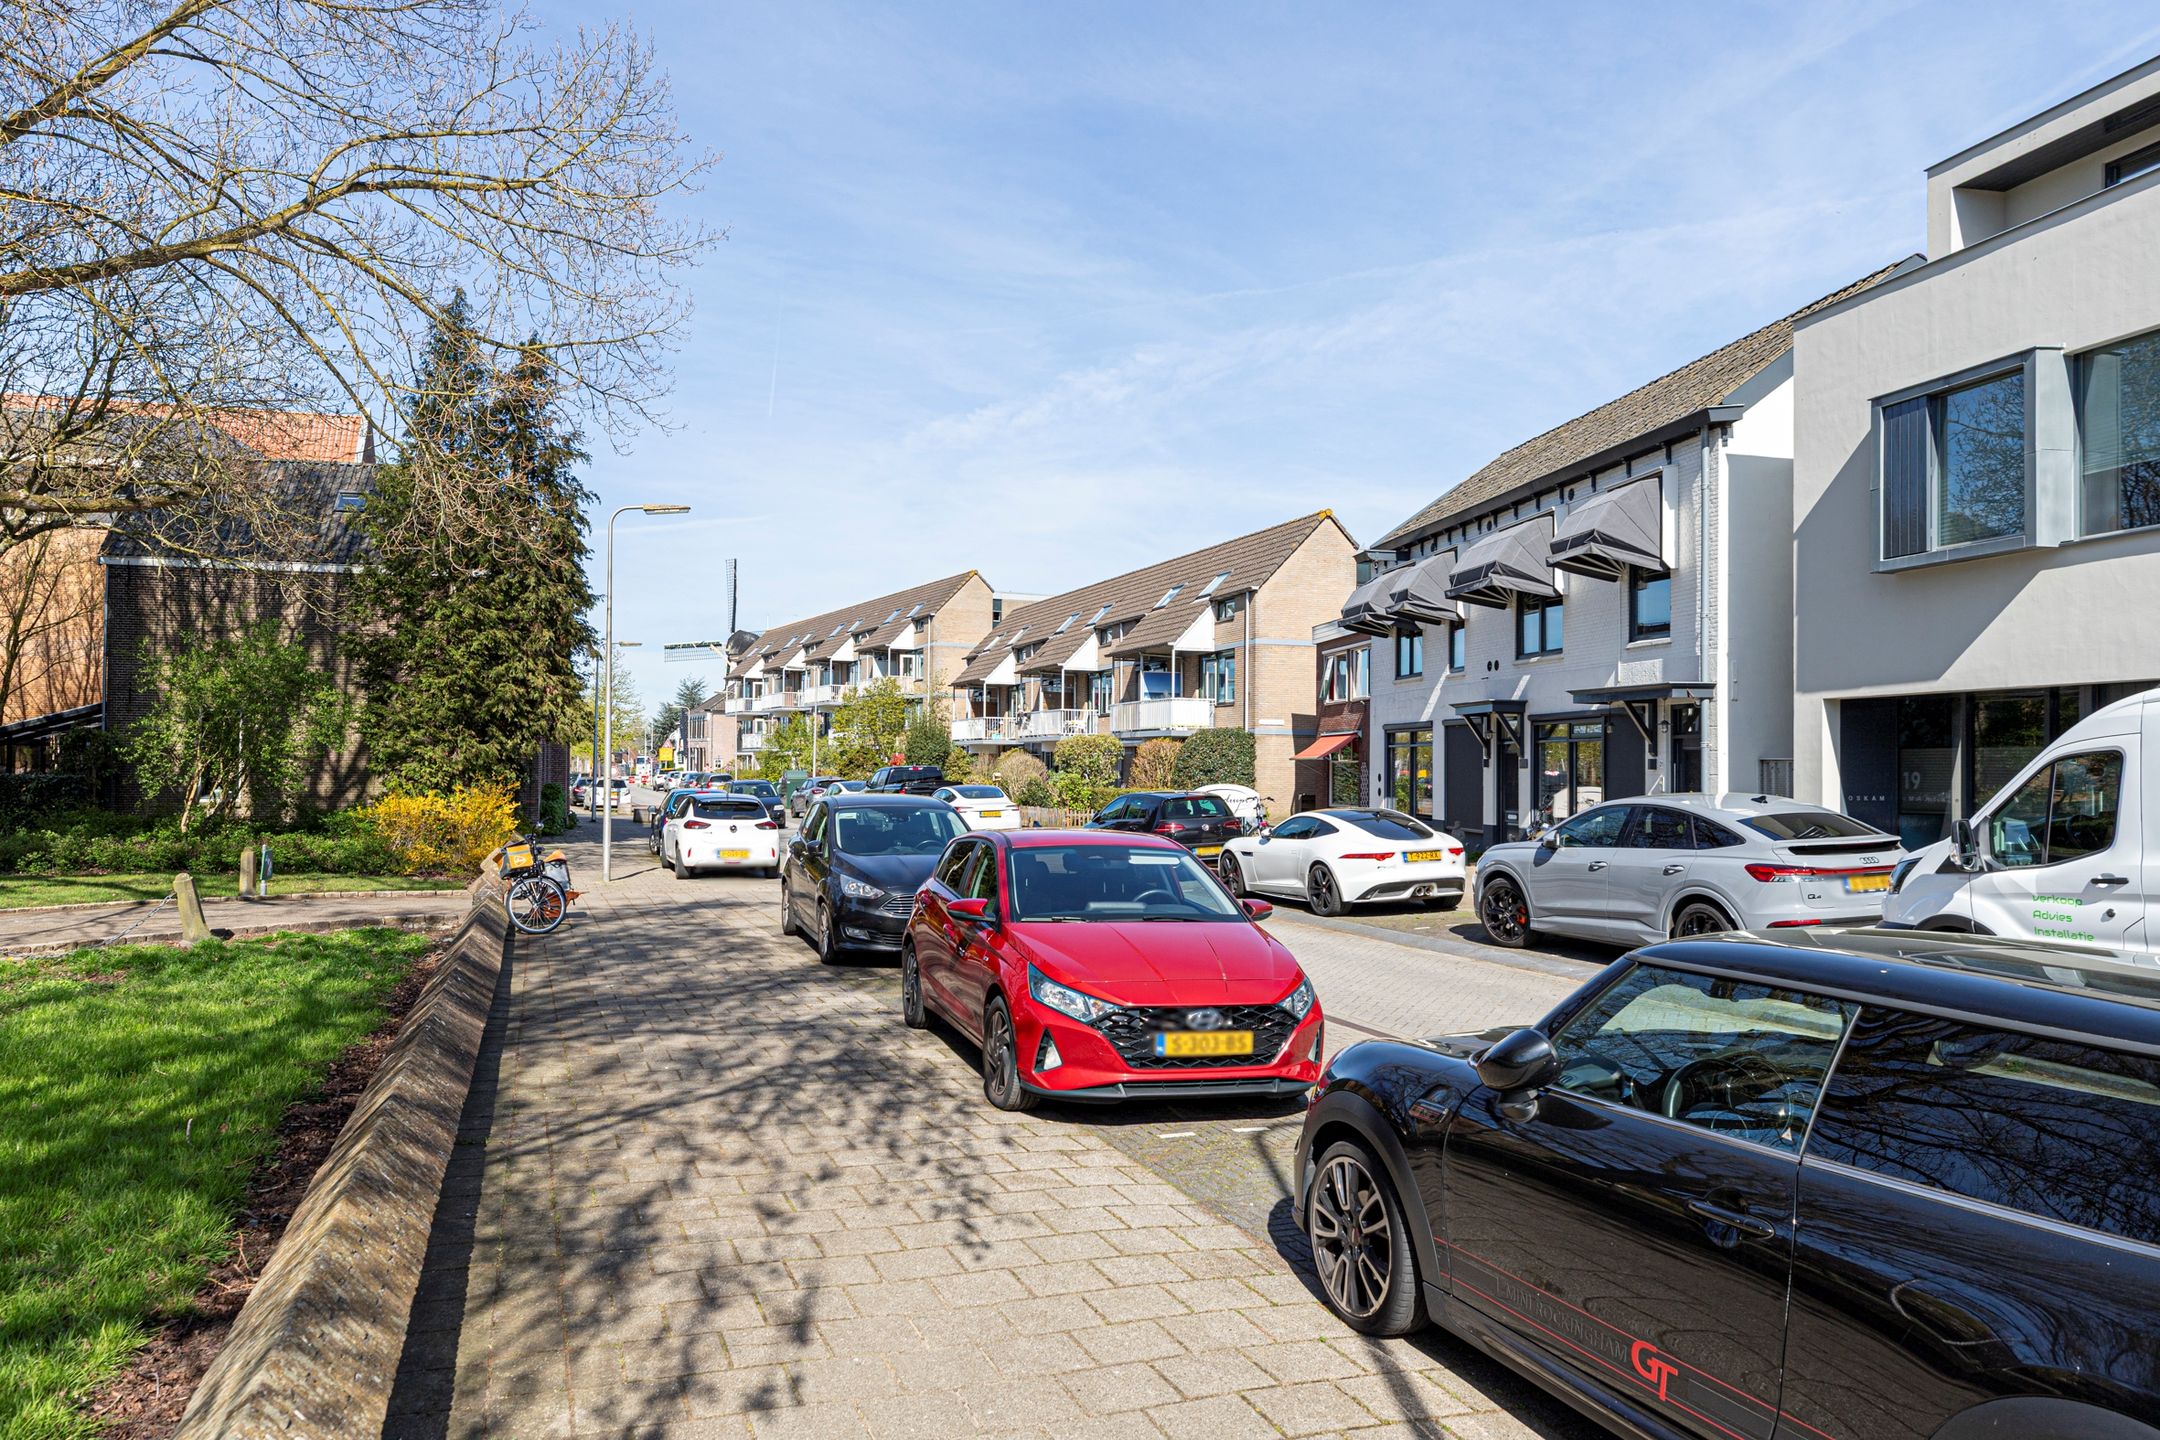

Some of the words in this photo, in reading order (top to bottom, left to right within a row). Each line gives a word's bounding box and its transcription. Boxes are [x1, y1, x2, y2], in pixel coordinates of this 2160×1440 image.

[1902, 771, 1921, 790] 19
[1847, 794, 1886, 802] OSKAM
[2032, 910, 2073, 923] Advies
[2033, 926, 2096, 942] Installatie
[1535, 1302, 1628, 1363] ROCKINGHAM
[1631, 1340, 1679, 1402] GT
